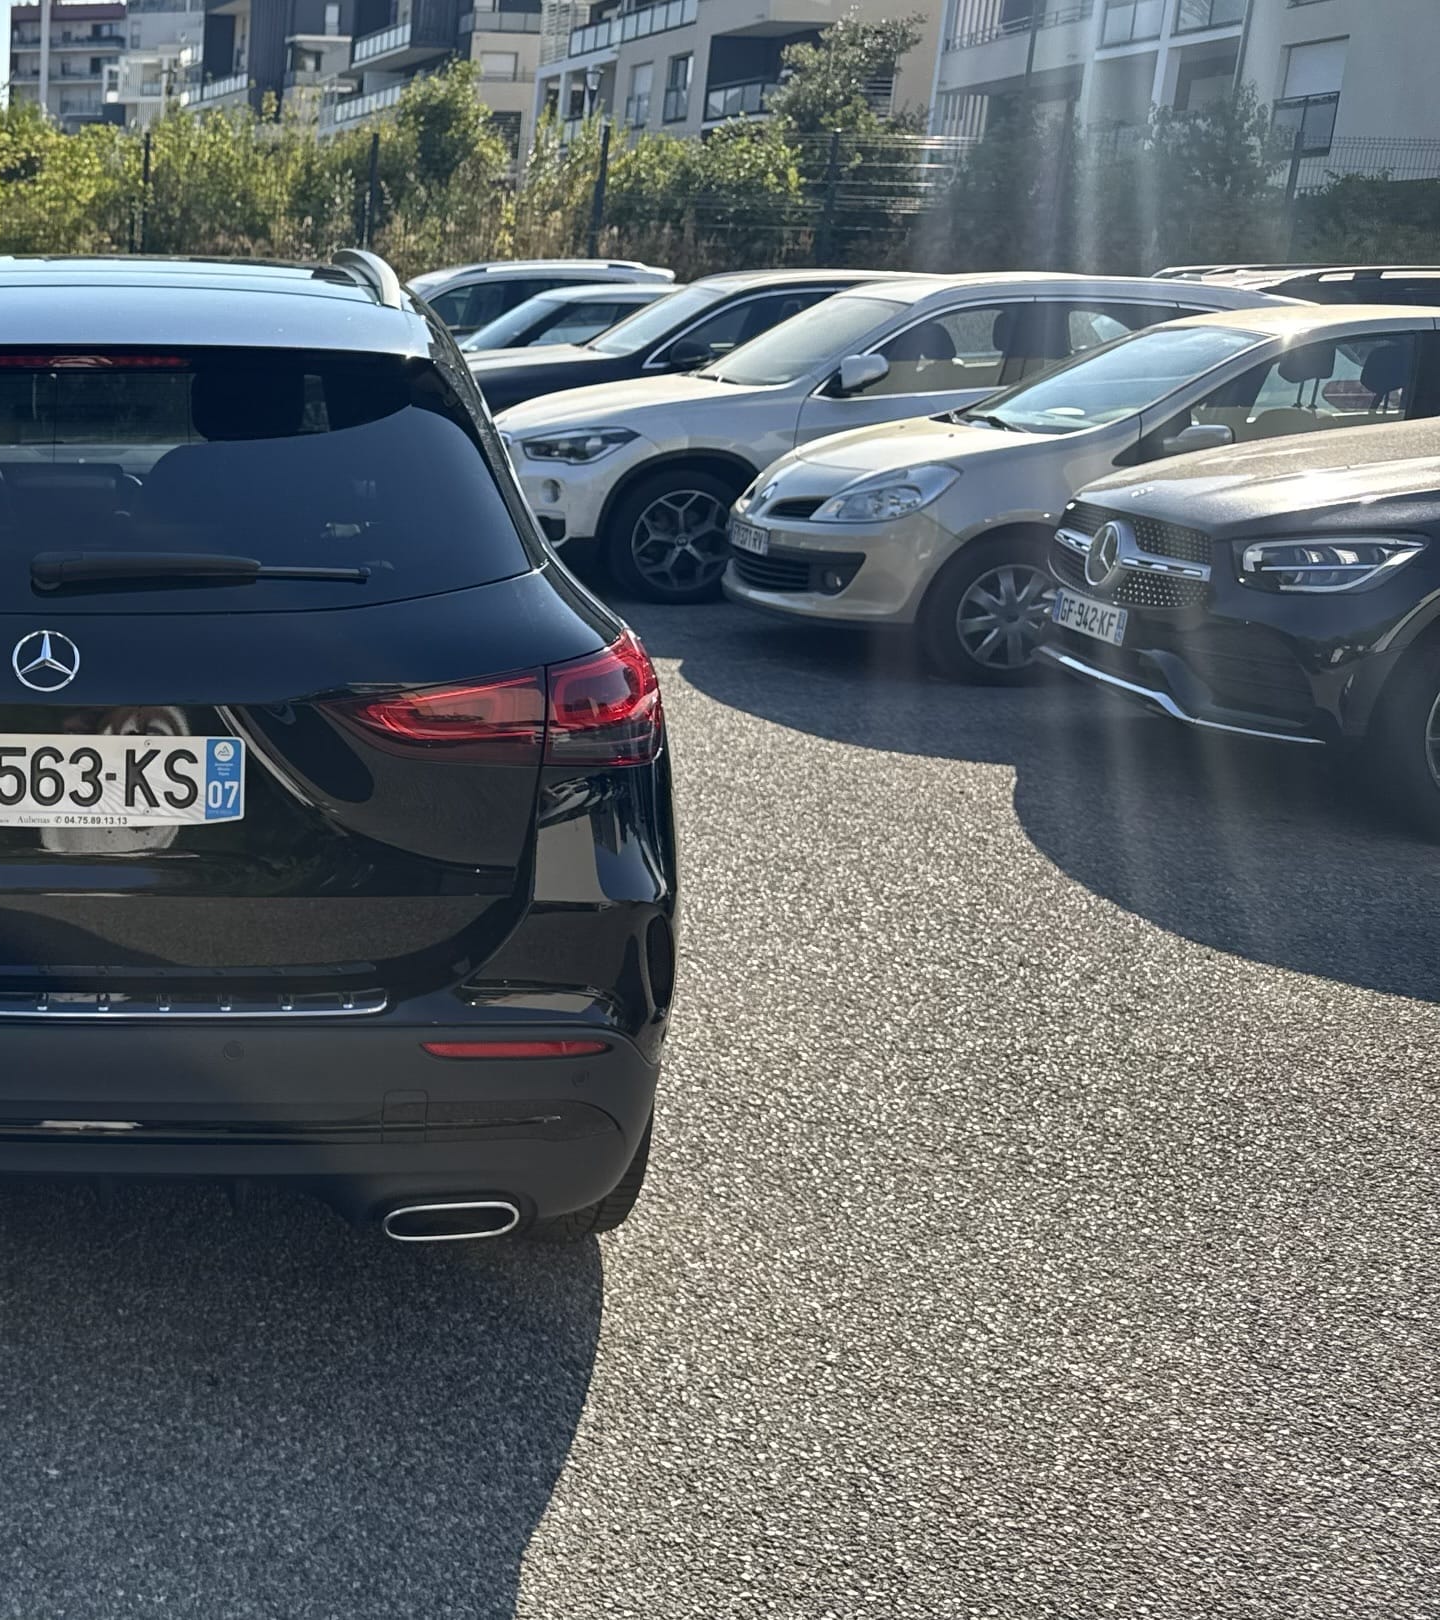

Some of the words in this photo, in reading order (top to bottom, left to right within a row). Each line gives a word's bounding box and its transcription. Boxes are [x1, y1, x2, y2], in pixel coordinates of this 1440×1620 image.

[1060, 597, 1117, 637] GF-942-KF
[207, 780, 240, 809] 07
[63, 815, 129, 825] 04.75.89.13.13
